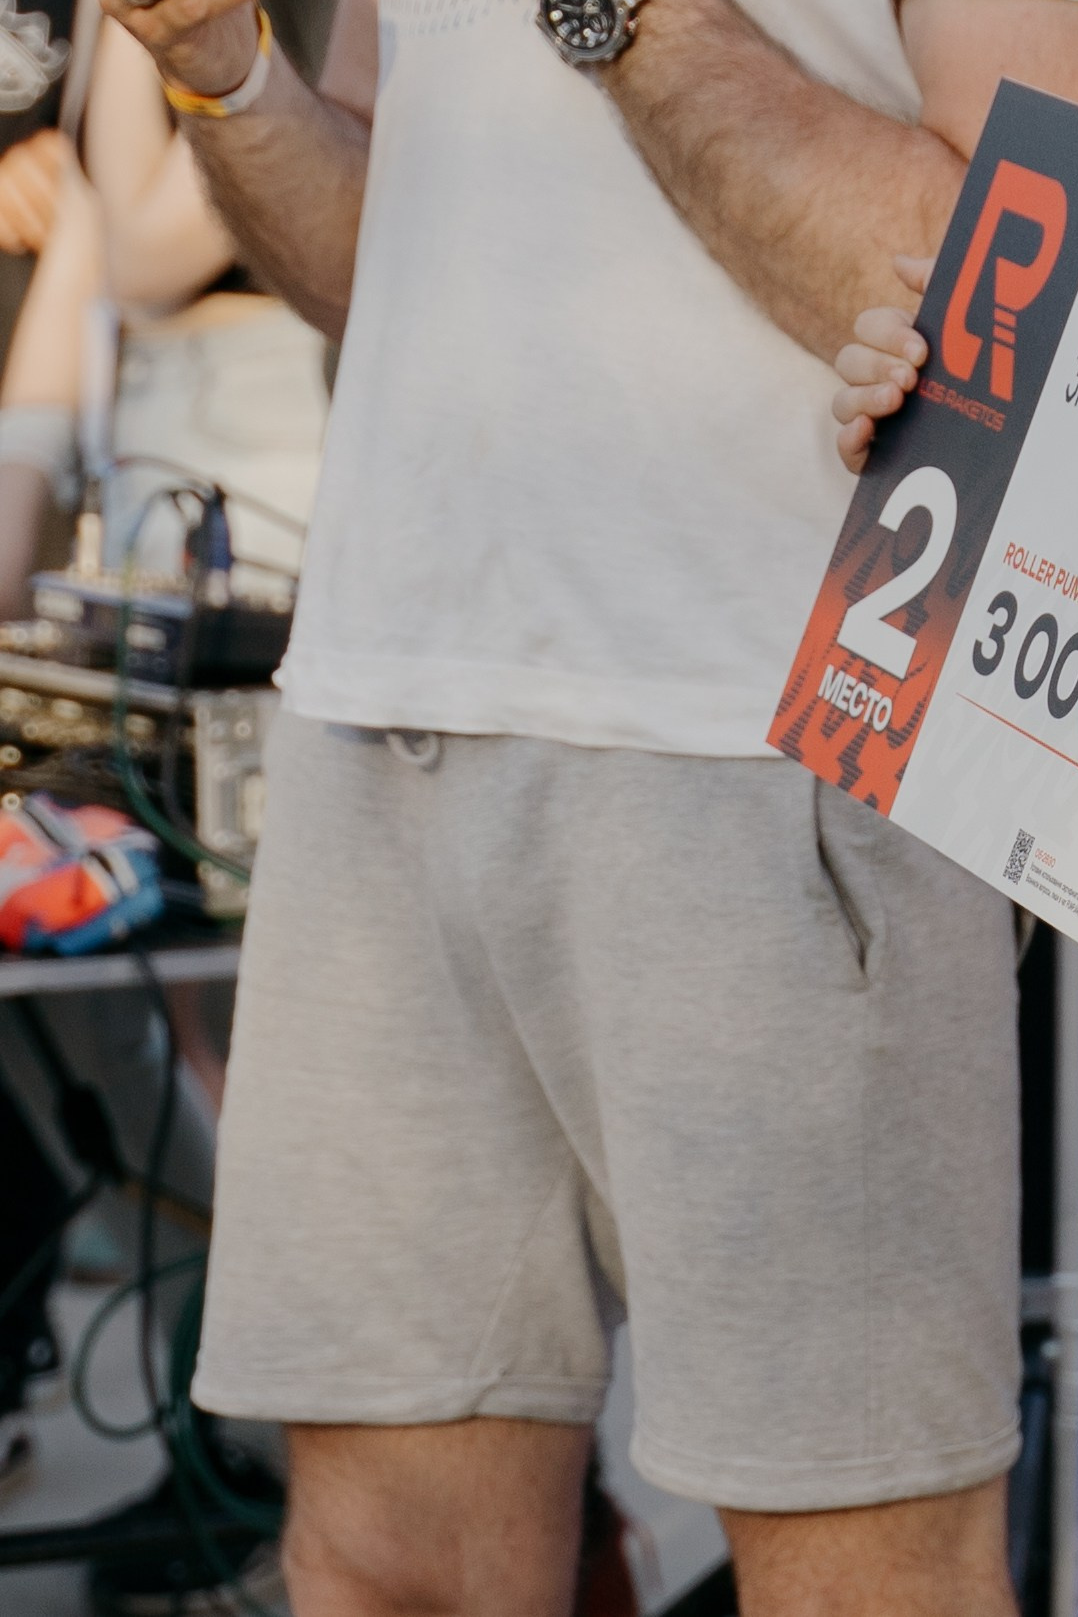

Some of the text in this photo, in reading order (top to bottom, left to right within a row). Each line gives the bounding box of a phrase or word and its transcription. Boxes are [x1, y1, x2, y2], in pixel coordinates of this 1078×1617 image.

[837, 465, 958, 680] 2
[1003, 542, 1056, 585] ROLLER
[817, 663, 893, 732] МЕСТО
